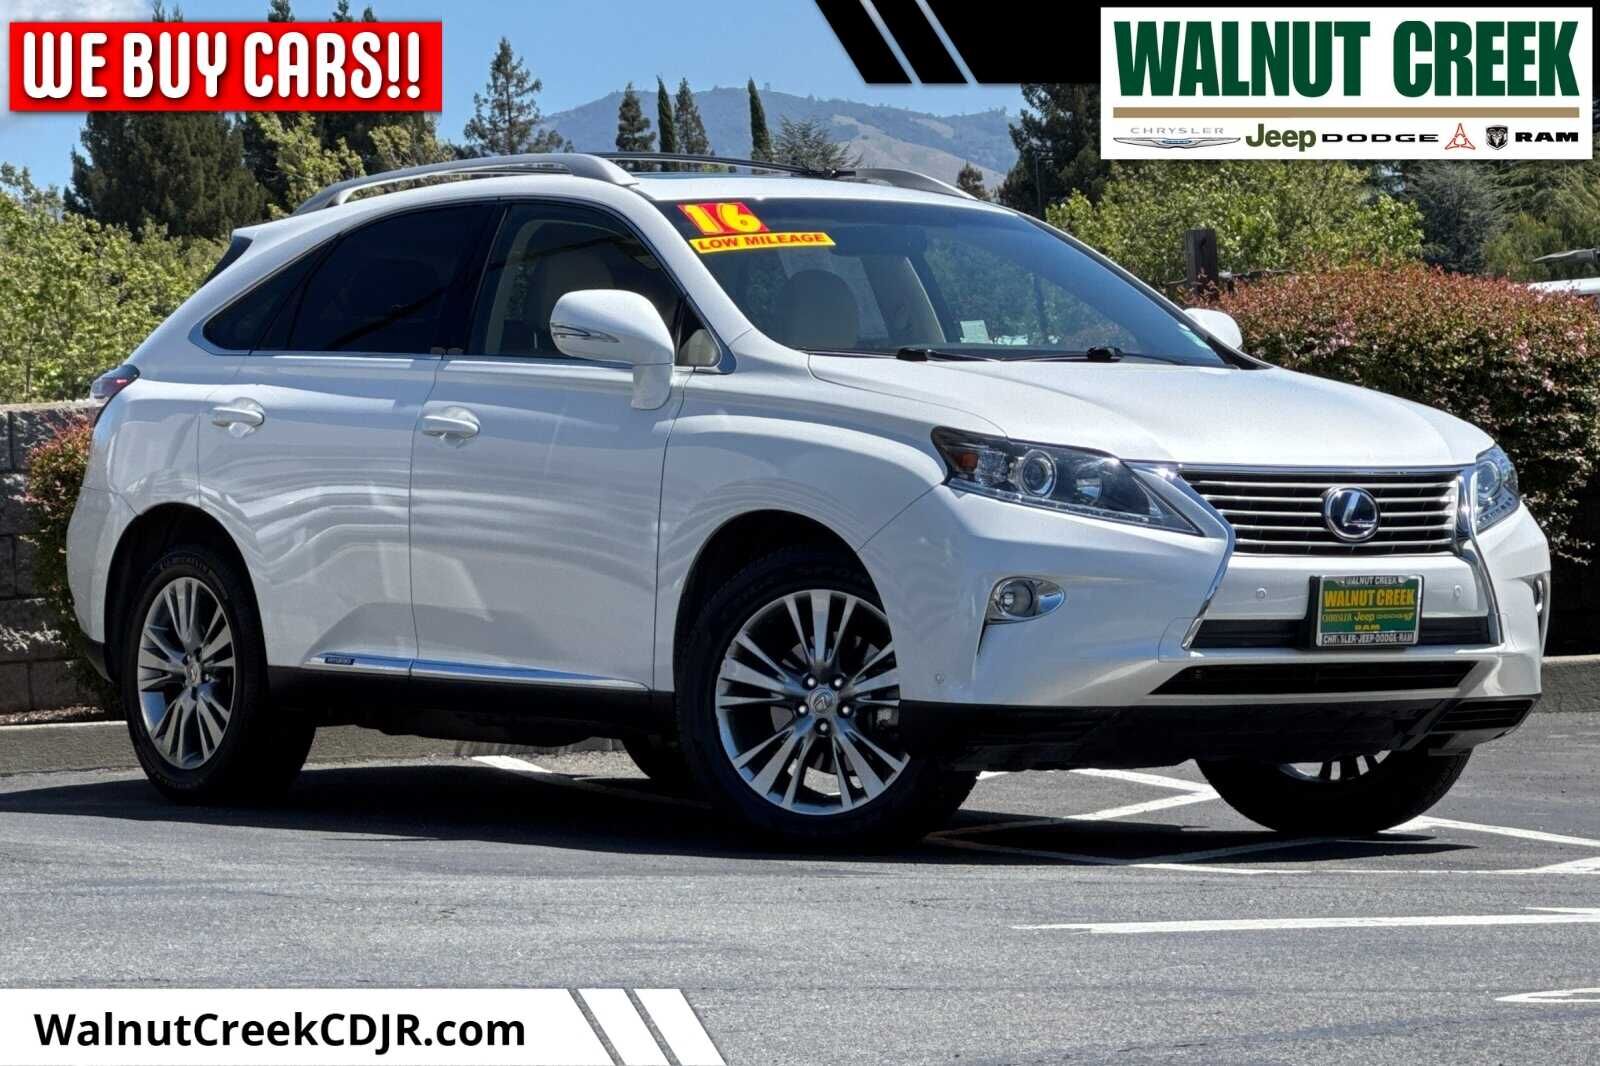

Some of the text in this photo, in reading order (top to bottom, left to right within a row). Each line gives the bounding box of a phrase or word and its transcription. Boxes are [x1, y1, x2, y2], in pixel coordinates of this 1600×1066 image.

[682, 203, 761, 233] 16
[698, 234, 826, 250] LOW MILEAGE
[1325, 589, 1415, 607] WALNUT CREEK
